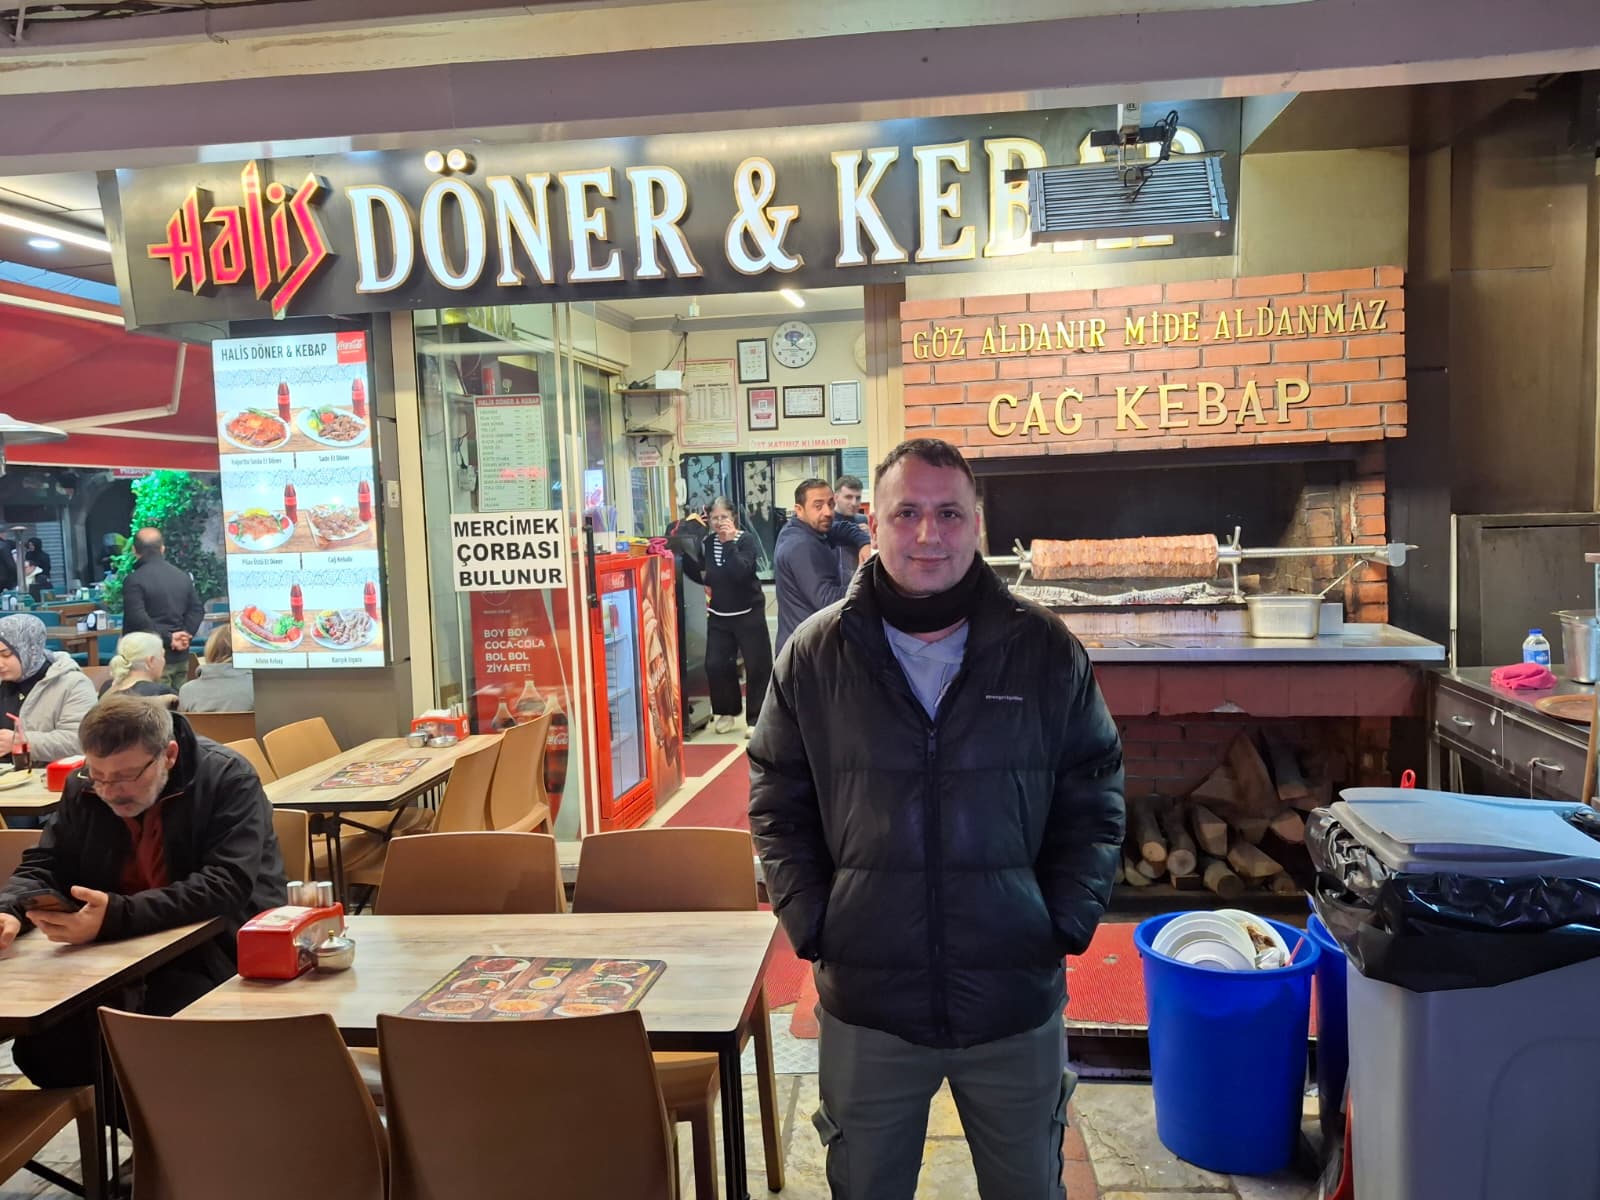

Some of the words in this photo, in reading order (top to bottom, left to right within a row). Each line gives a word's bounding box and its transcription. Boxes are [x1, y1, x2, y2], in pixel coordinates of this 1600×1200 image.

[346, 148, 703, 294] DÖNER
[725, 156, 804, 275] &
[831, 125, 1206, 268] KEB
[912, 327, 966, 360] GÖZ
[980, 318, 1108, 355] ALDANIR
[1125, 310, 1200, 347] MİDE
[1214, 299, 1388, 341] ALDANMAZ
[221, 344, 249, 361] HALİS
[252, 344, 283, 360] DÖNER
[286, 346, 293, 358] &
[295, 343, 327, 358] KEBAP
[988, 387, 1084, 437] CAĞ
[1116, 377, 1312, 432] KEBAP
[454, 516, 559, 538] MERCİMEK
[457, 540, 559, 567] ÇORBASI
[459, 568, 562, 587] BULUNUR
[483, 628, 505, 638] BOY
[507, 627, 529, 637] BOY
[484, 639, 545, 650] COCA-COLA
[485, 652, 506, 661] BOL
[508, 651, 529, 661] BOL
[486, 662, 531, 673] ZİYAFET!
